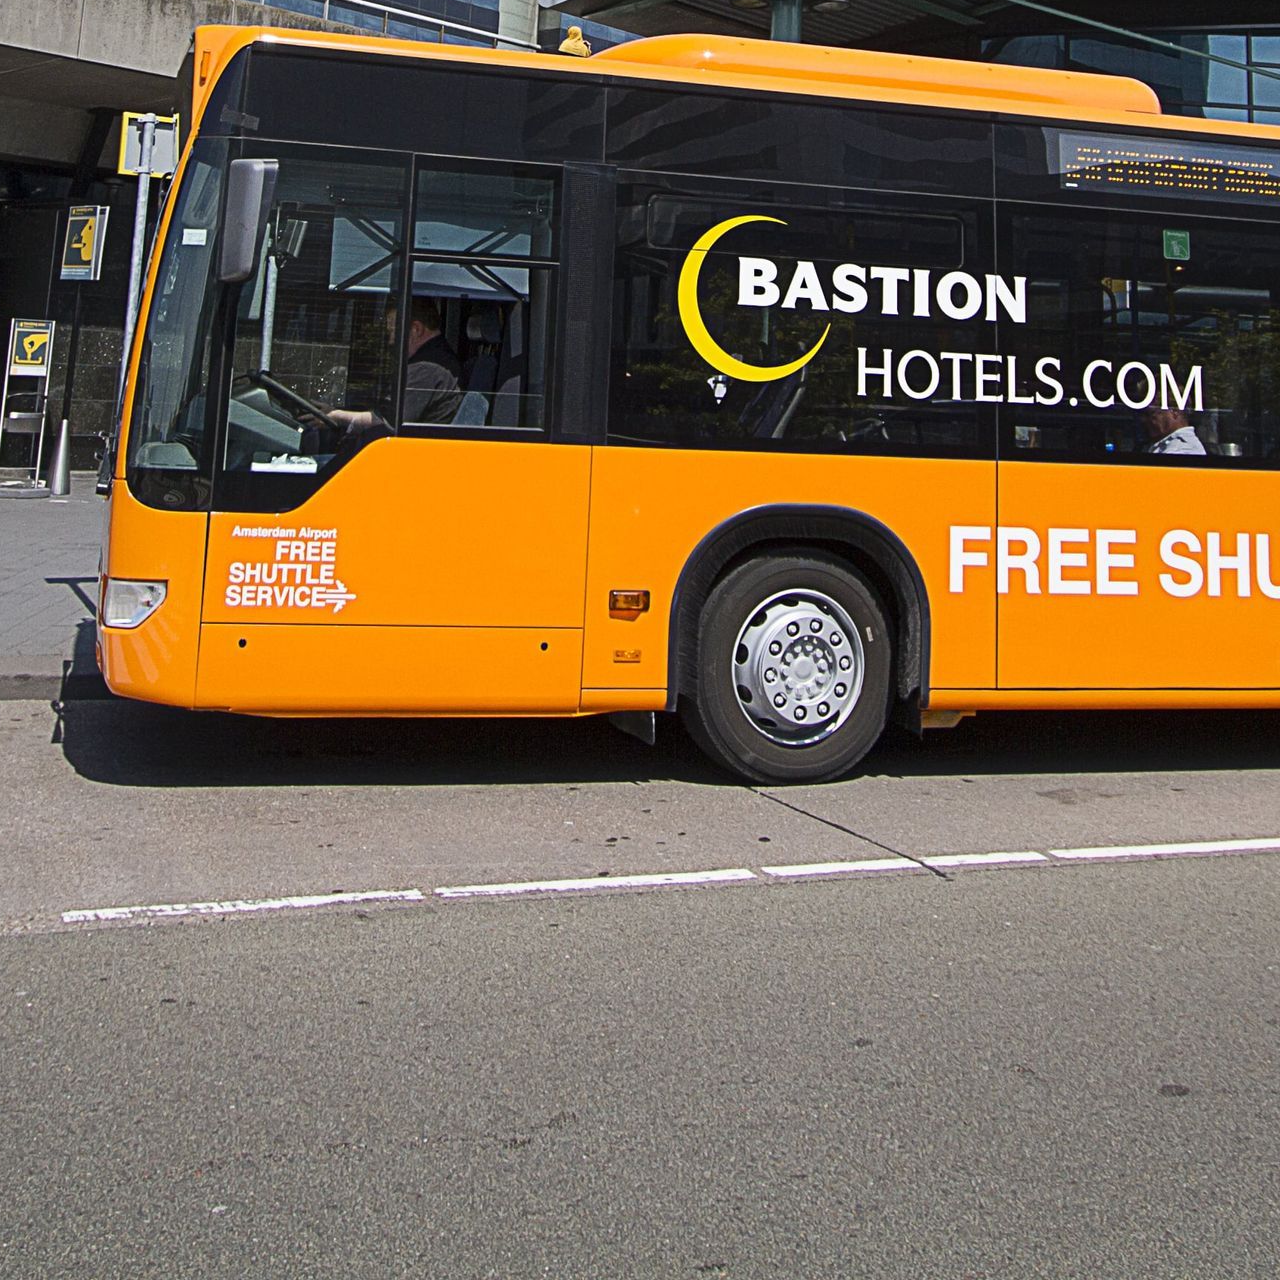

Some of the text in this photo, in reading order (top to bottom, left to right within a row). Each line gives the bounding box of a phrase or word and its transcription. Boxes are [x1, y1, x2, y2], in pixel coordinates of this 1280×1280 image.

[736, 255, 1027, 324] BASTION
[855, 346, 1205, 413] HOTELS.COM
[232, 525, 337, 540] Amsterdam Airport
[276, 541, 336, 562] FREE
[949, 524, 1139, 596] FREE
[228, 562, 336, 585] SHUTTLE
[225, 585, 327, 607] SERVICE
